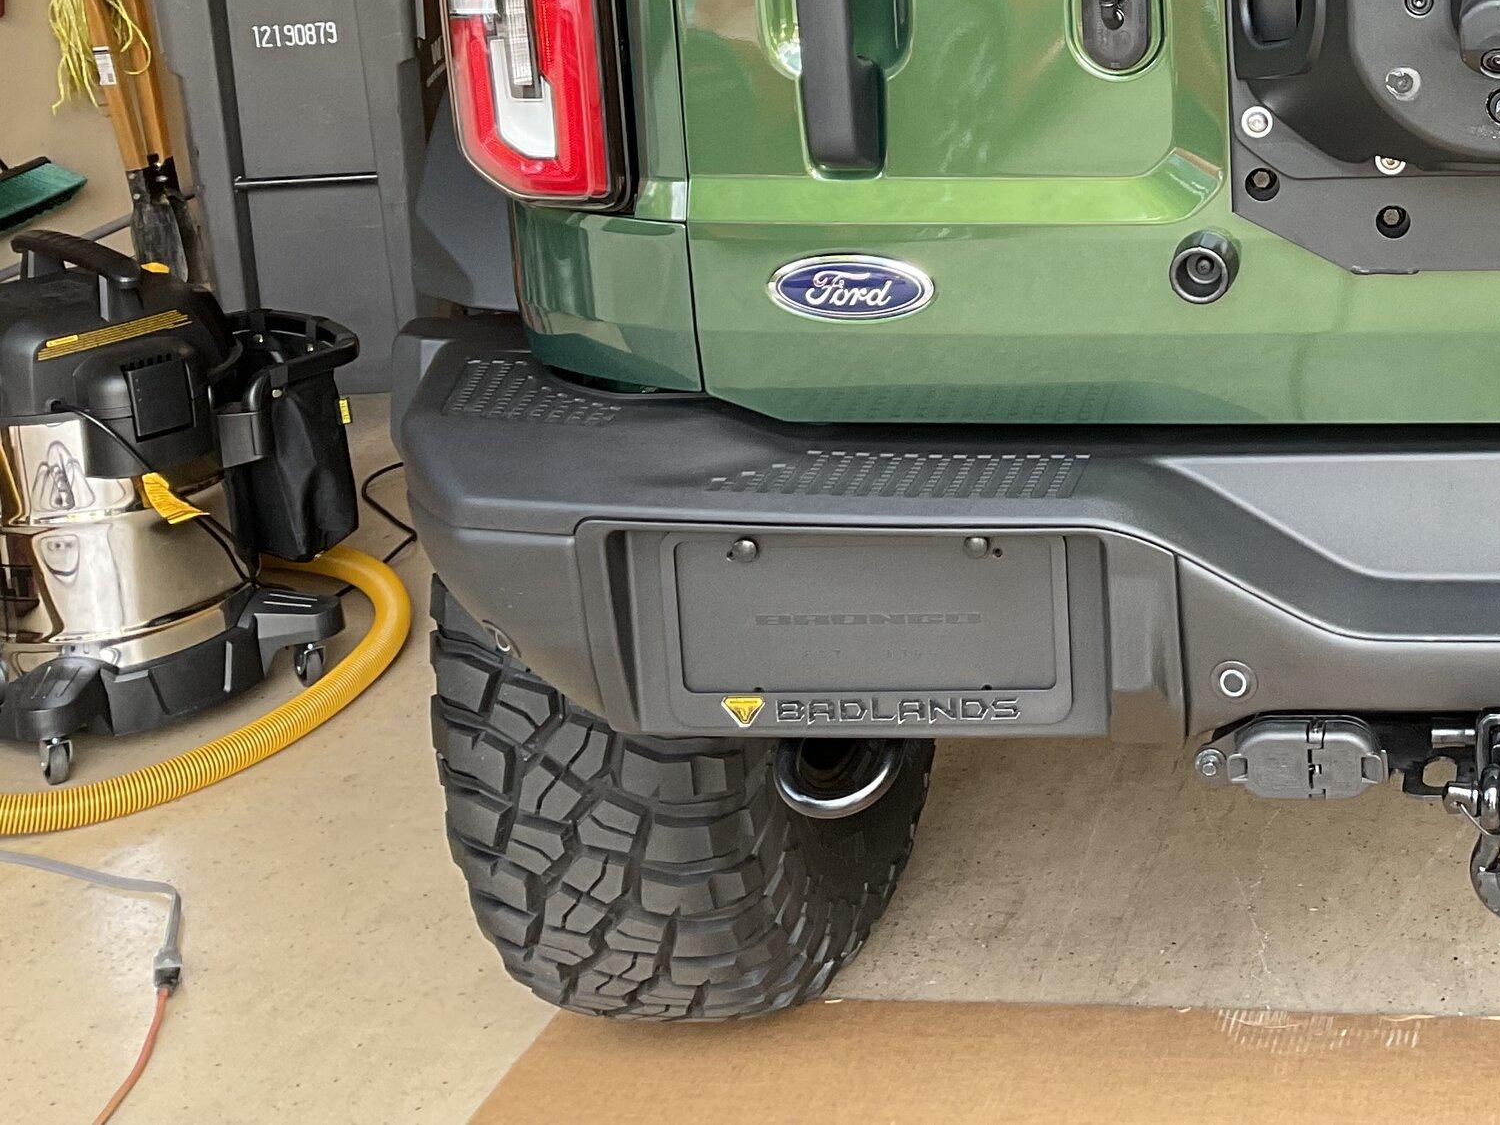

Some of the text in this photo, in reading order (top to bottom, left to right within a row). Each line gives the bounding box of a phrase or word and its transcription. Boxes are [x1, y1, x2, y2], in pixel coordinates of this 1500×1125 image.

[252, 21, 337, 48] 12190879
[805, 270, 893, 306] Ford
[755, 612, 982, 626] BRONCO
[775, 697, 1021, 725] BADLANDS
